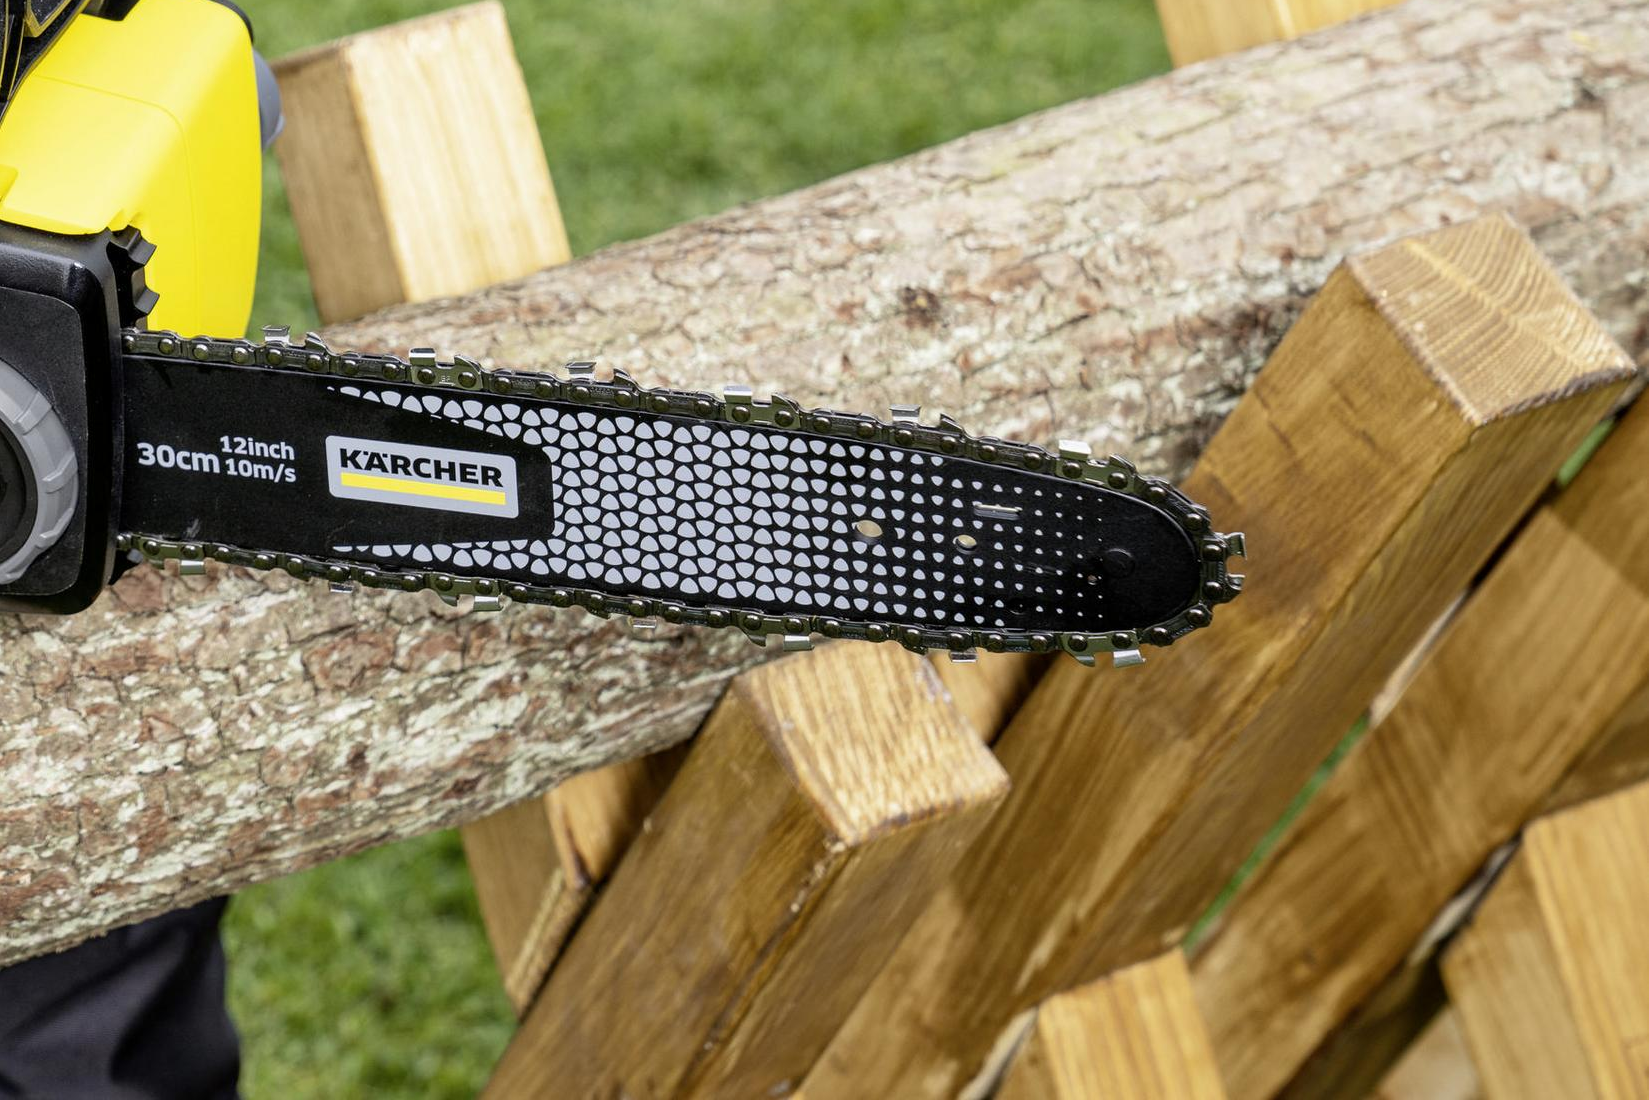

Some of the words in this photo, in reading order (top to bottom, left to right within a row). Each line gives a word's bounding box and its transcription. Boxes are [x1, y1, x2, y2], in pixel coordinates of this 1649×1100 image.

[136, 441, 221, 474] 30cm
[219, 435, 296, 461] 12inch
[226, 457, 297, 484] 10m/s
[339, 447, 505, 488] KÄRCHER
